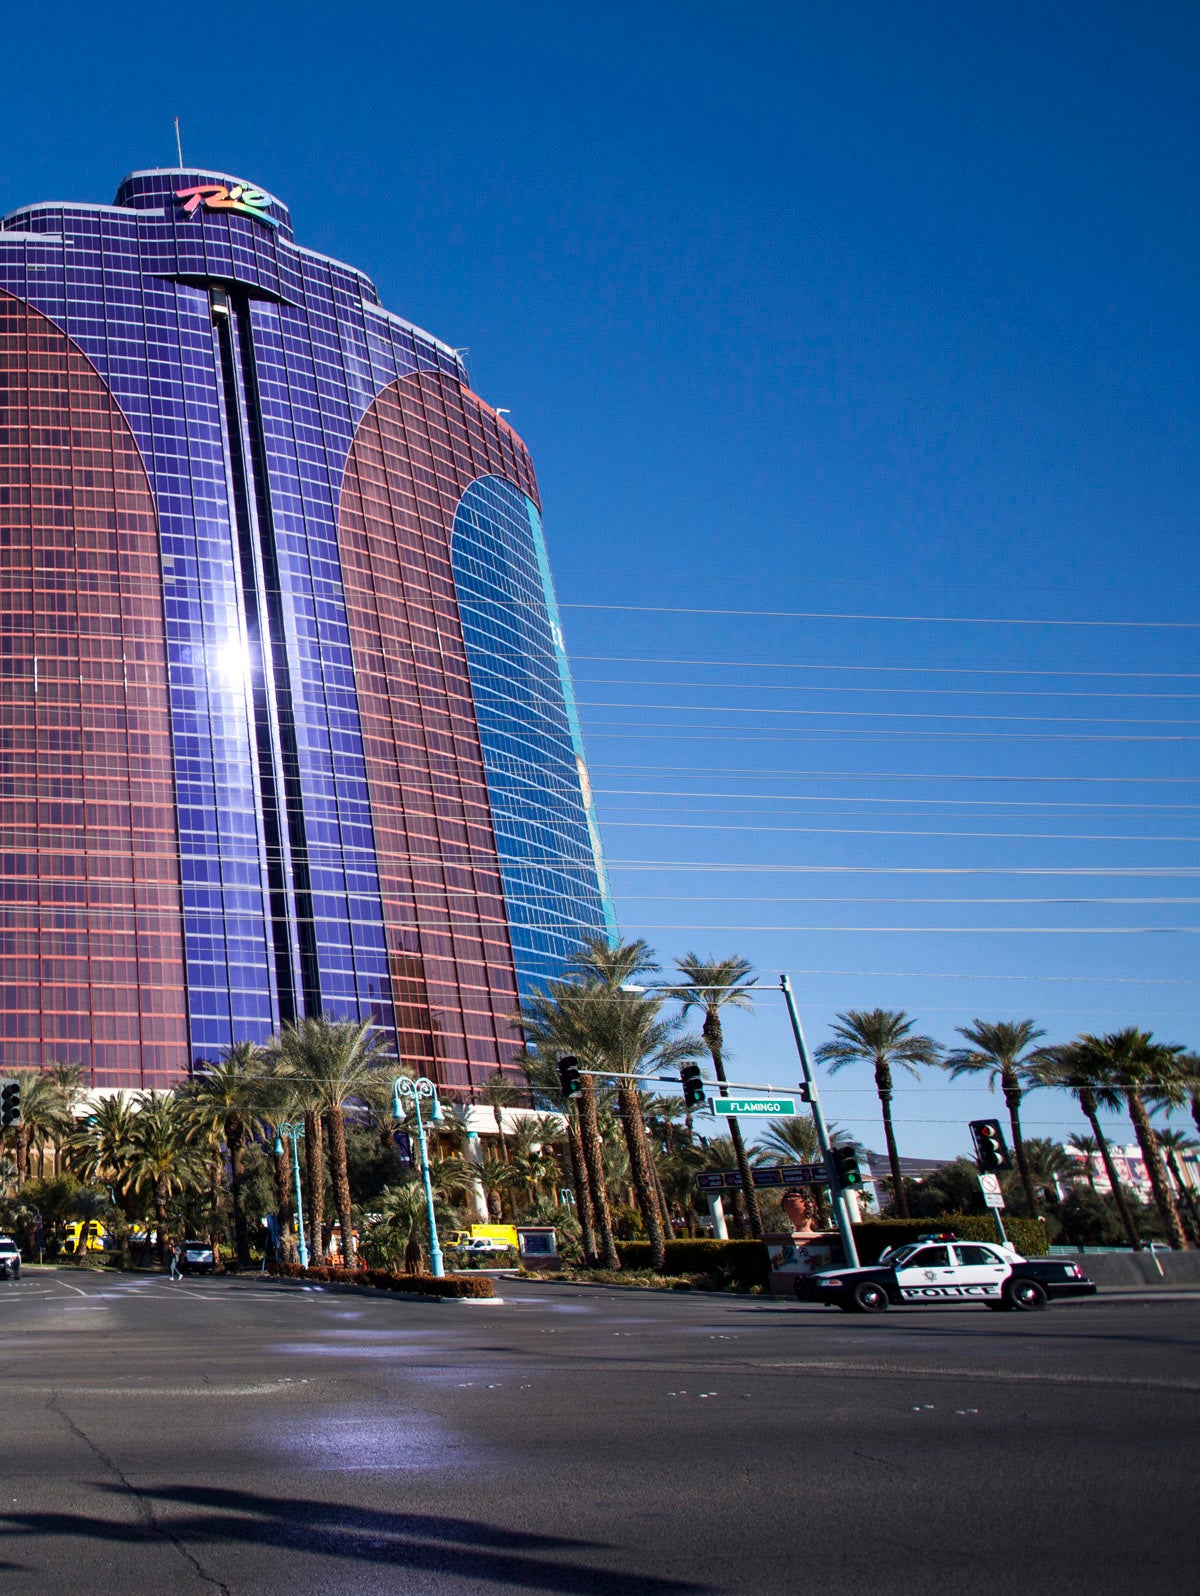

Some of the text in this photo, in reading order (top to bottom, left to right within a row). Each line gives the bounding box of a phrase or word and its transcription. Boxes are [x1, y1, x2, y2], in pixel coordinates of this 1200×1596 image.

[175, 182, 280, 229] Rio
[730, 1102, 780, 1112] FLAMINGO
[904, 1286, 999, 1297] POLICE
